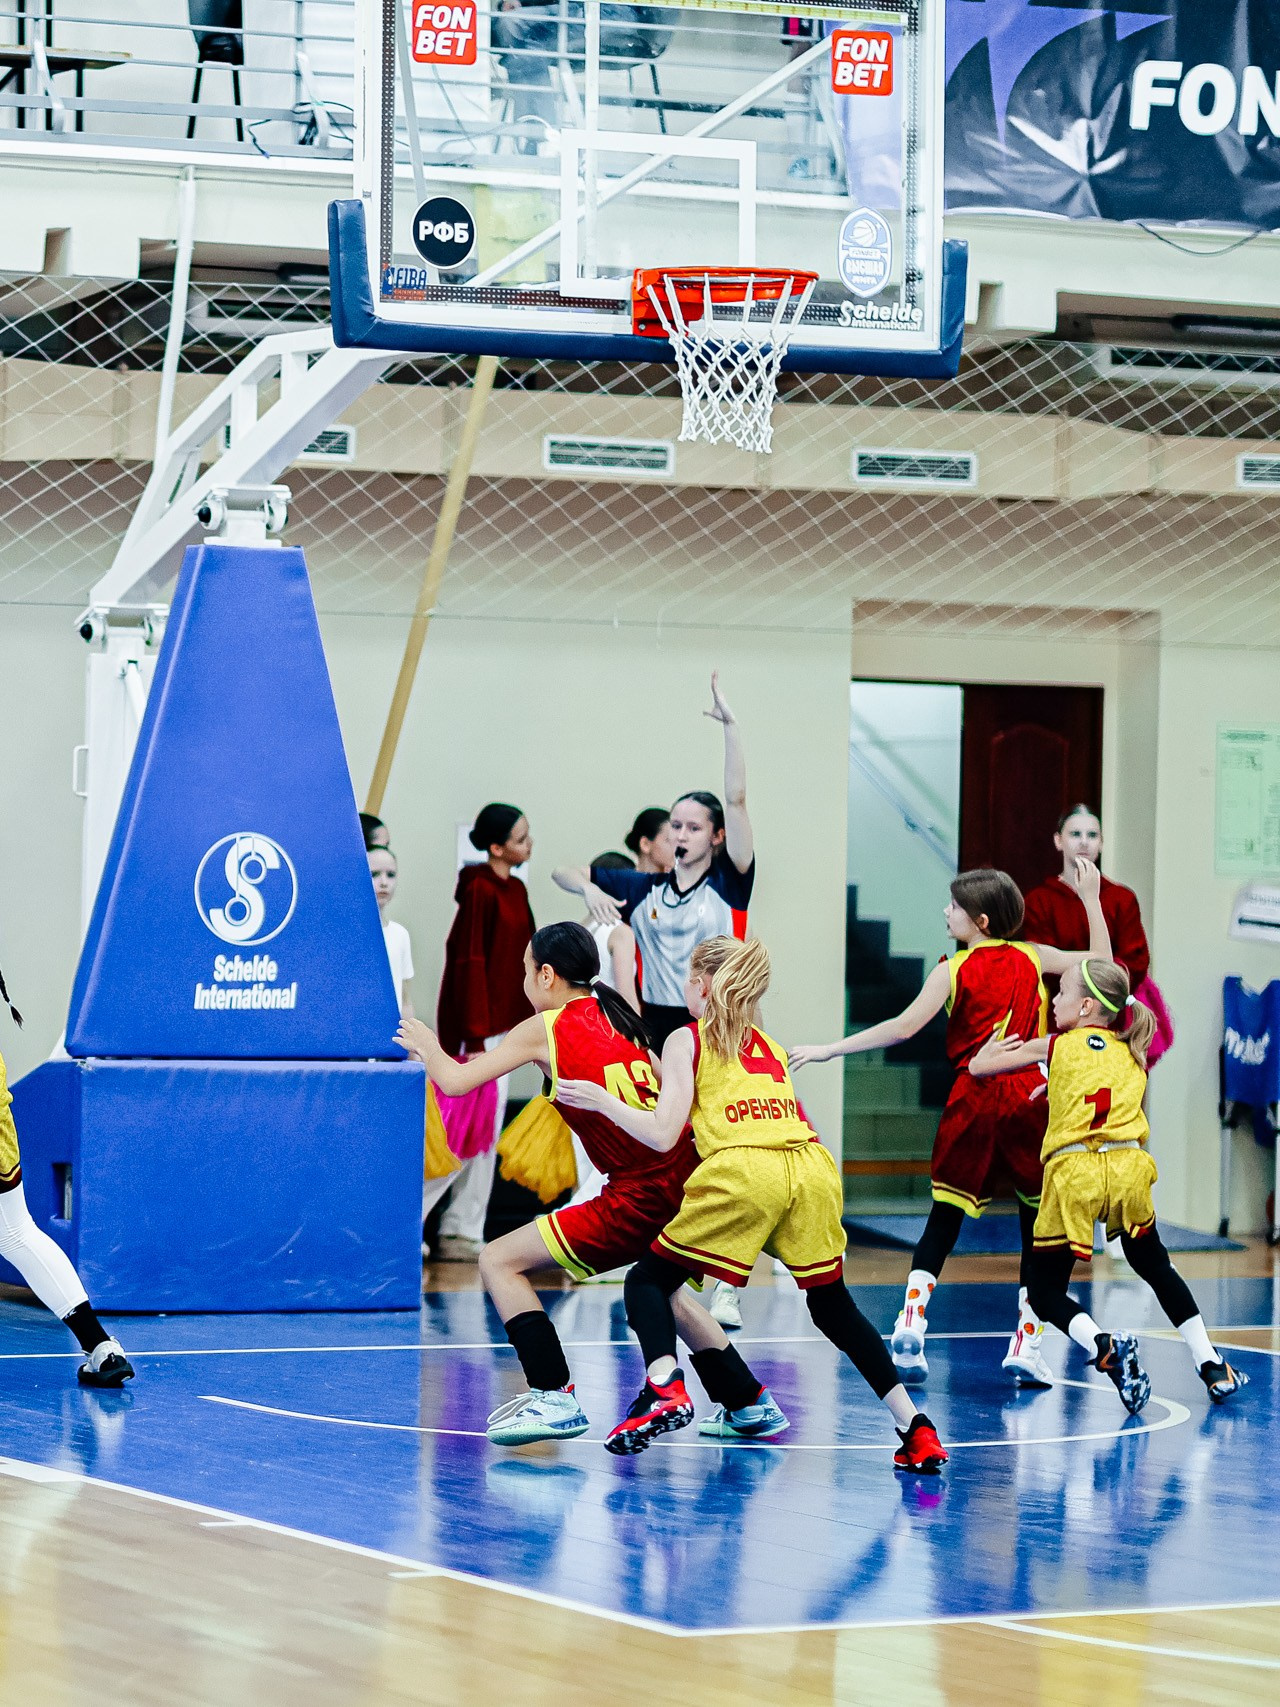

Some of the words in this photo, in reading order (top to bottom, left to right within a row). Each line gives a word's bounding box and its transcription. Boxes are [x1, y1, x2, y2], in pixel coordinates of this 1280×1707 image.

[415, 4, 473, 31] FON
[415, 29, 473, 57] BET
[834, 36, 889, 63] FON
[834, 61, 889, 89] BET
[418, 220, 469, 244] РФБ
[396, 267, 427, 290] FIBA
[837, 300, 924, 328] Schelde
[213, 954, 278, 982] Schelde
[193, 982, 298, 1010] International
[737, 1026, 787, 1084] 4
[724, 1098, 796, 1123] ОРЕНБУР
[1084, 1087, 1112, 1131] 1
